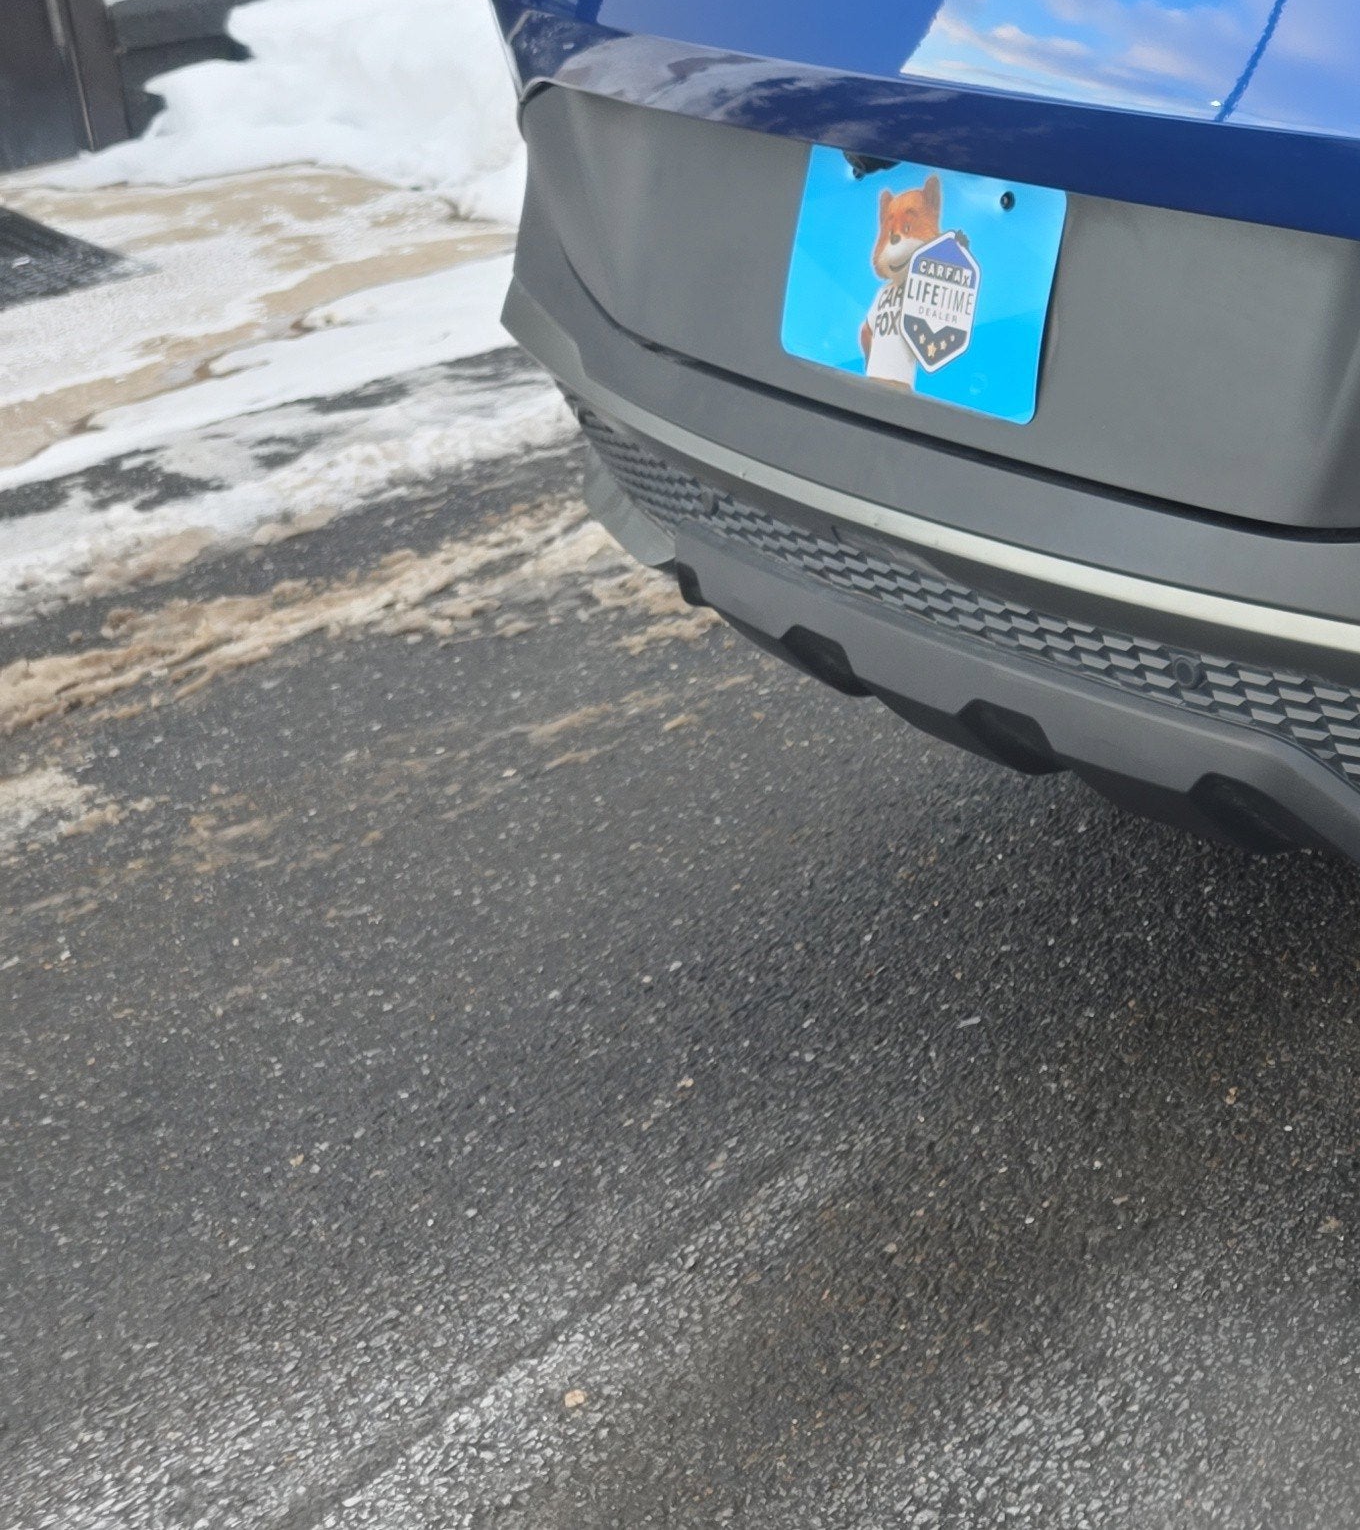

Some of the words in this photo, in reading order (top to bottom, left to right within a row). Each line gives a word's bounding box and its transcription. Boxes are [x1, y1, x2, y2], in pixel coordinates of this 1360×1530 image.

[920, 260, 972, 288] CARFAX
[907, 278, 974, 316] LIFETIME
[875, 310, 902, 336] FOX
[919, 306, 958, 324] DEALER
